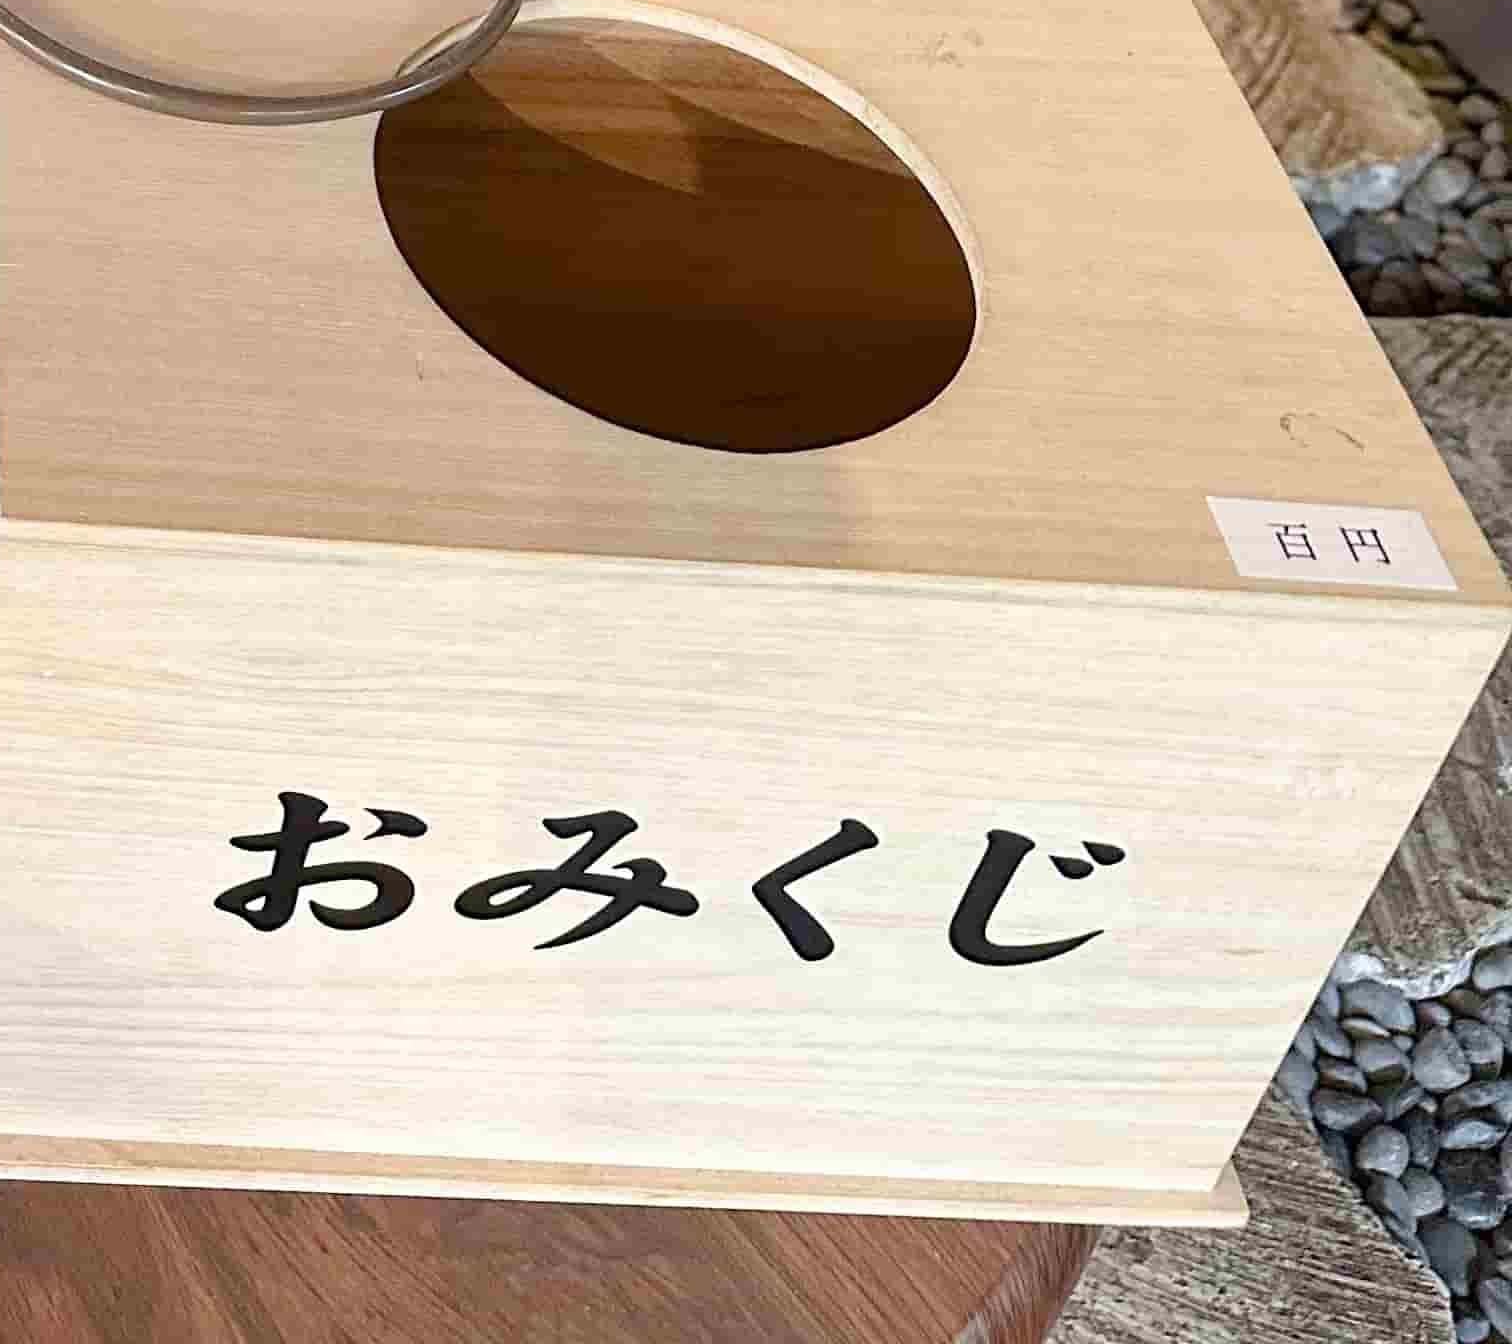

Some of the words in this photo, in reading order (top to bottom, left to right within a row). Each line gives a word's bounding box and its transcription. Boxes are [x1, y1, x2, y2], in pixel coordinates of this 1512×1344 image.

[1267, 521, 1396, 570] 百円
[214, 791, 1128, 969] おみくじ
